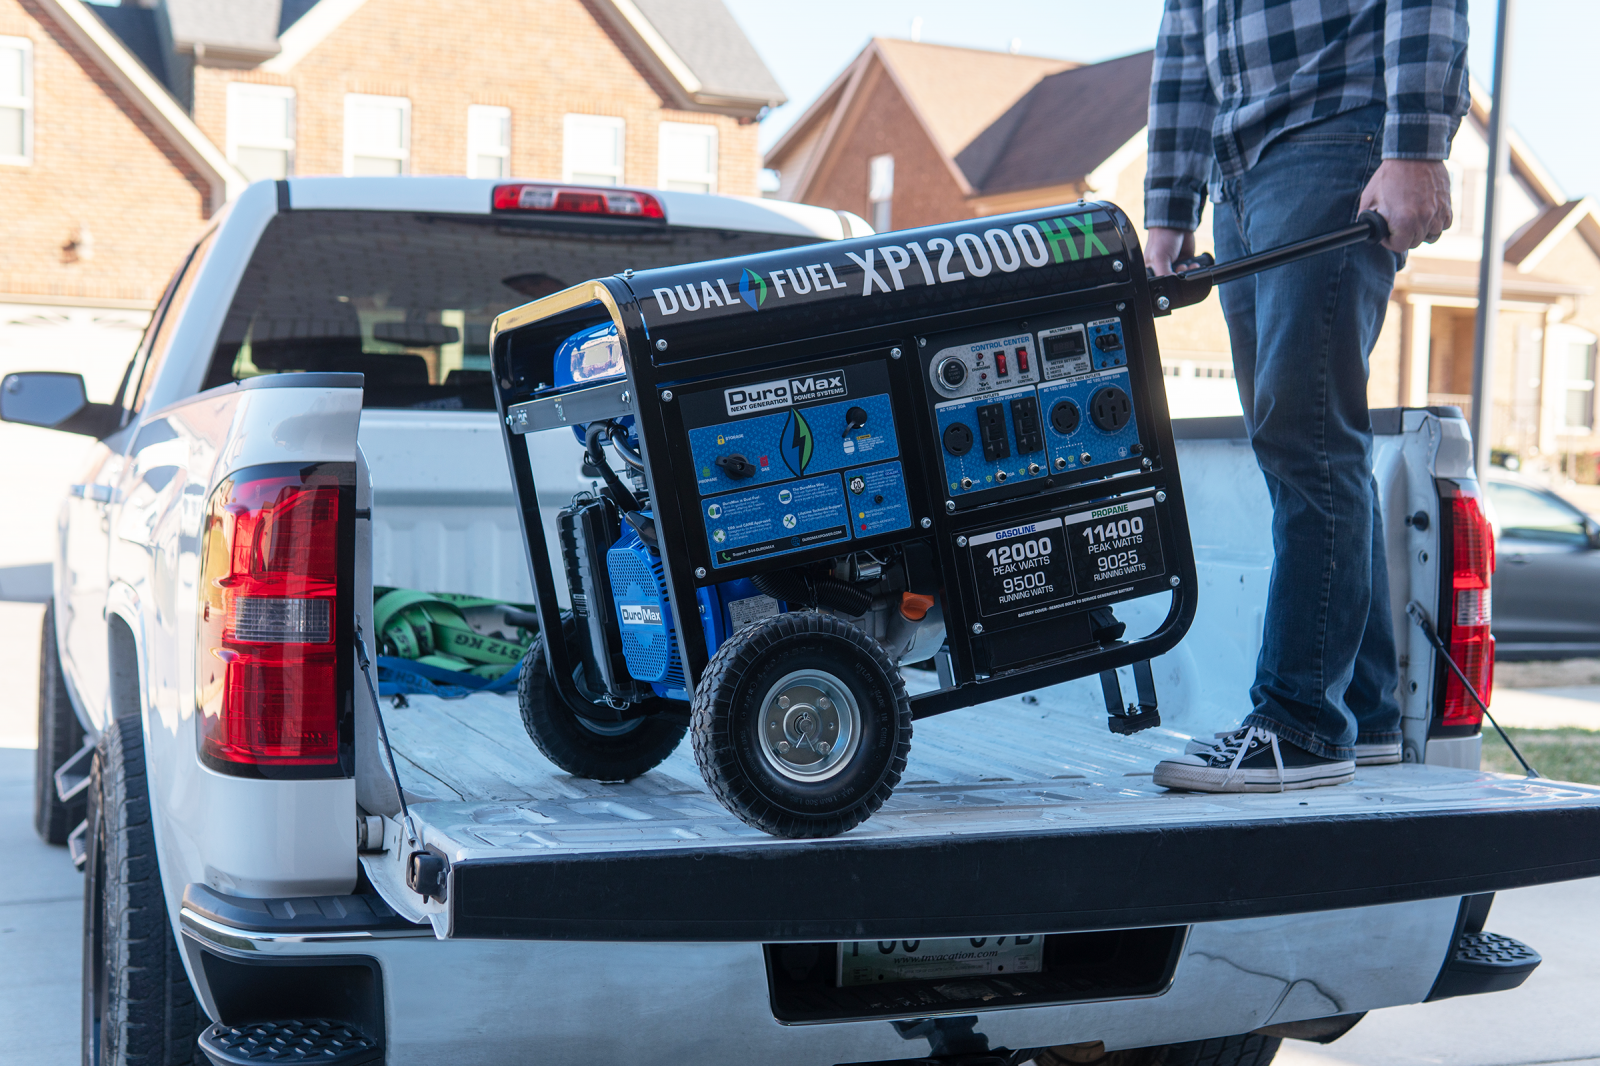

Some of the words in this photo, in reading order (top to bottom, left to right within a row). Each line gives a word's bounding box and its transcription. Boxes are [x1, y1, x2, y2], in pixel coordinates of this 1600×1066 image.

[652, 278, 741, 316] DUAL
[769, 262, 847, 299] FUEL
[970, 342, 1002, 352] CONTROL
[1004, 336, 1030, 346] CENTER
[730, 404, 748, 413] NEXT
[748, 397, 789, 411] GENERATION
[794, 392, 816, 402] POWER
[816, 387, 845, 397] SYSTEMS
[1091, 504, 1129, 519] PROPANE
[995, 524, 1037, 540] GASOLINE
[1082, 516, 1144, 545] 11400
[986, 536, 1053, 567] 12000
[1088, 541, 1112, 555] PEAK
[1112, 534, 1143, 549] WATTS
[993, 563, 1018, 577] PEAK
[1018, 556, 1051, 571] WATTS
[1097, 549, 1139, 572] 9025
[1093, 568, 1124, 582] RUNNING
[1124, 562, 1147, 575] WATTS
[1002, 571, 1046, 594] 9500
[998, 590, 1030, 604] RUNNING
[1030, 584, 1054, 597] WATTS
[1017, 610, 1035, 618] BATTERY
[454, 634, 484, 650] KG
[894, 951, 999, 965] www.tnvacation.com
